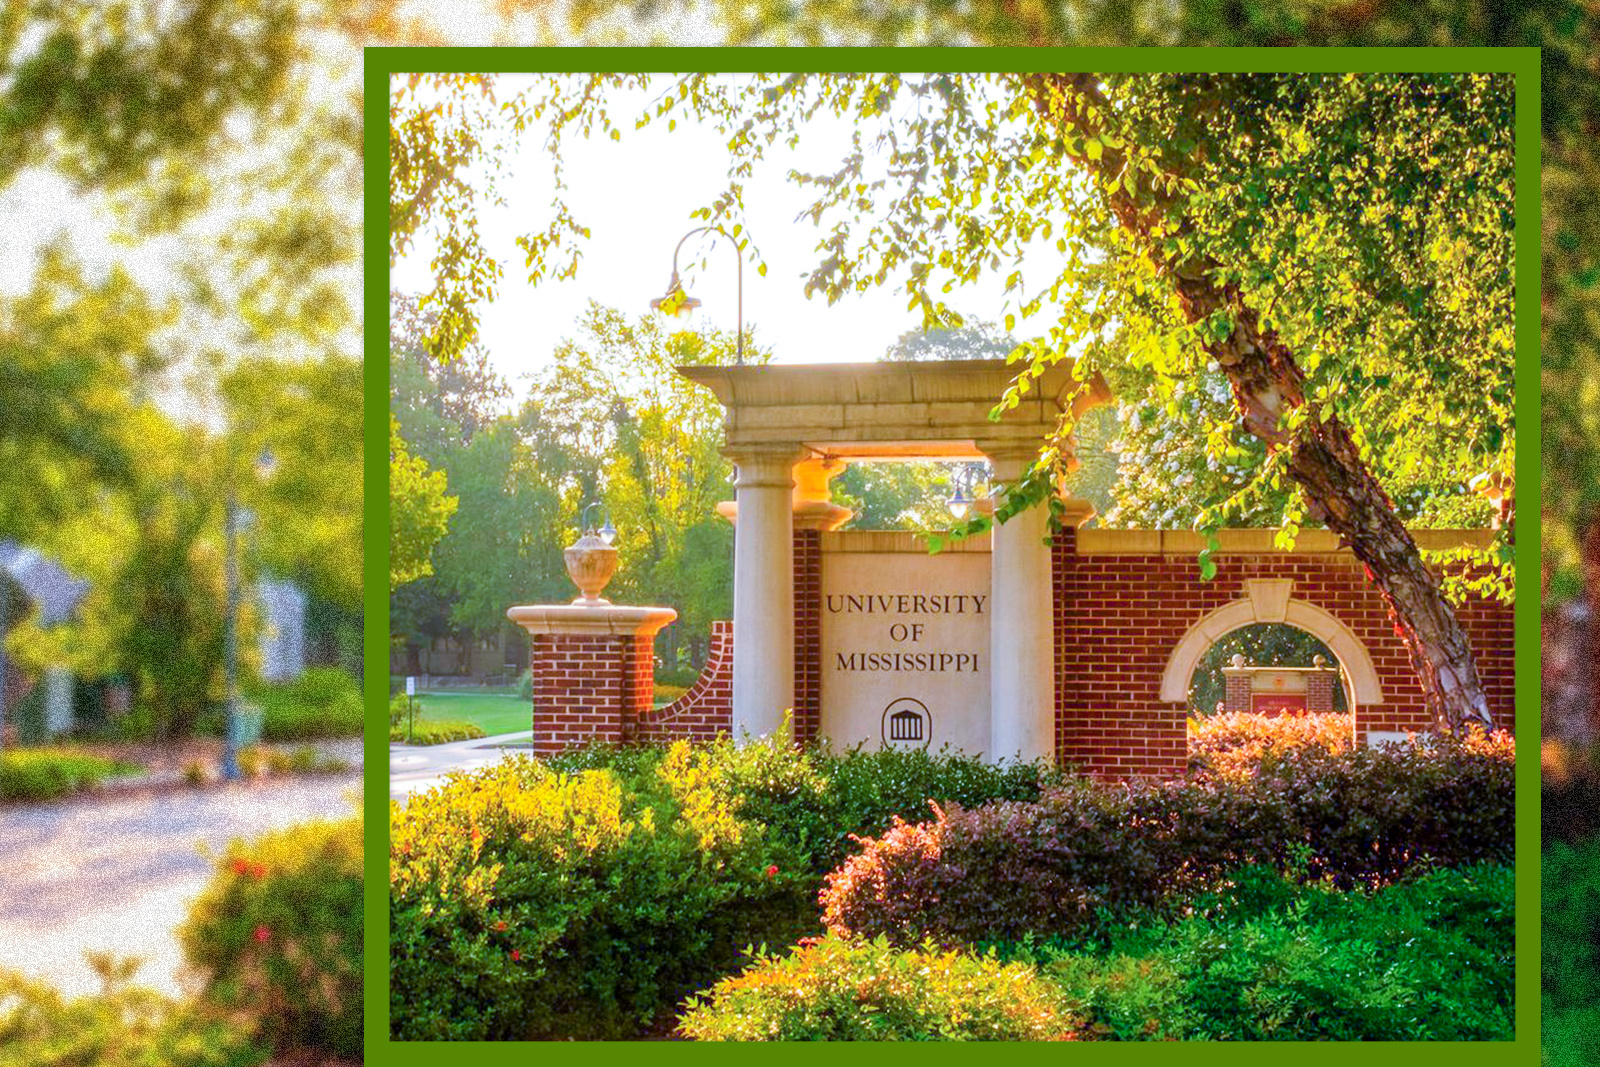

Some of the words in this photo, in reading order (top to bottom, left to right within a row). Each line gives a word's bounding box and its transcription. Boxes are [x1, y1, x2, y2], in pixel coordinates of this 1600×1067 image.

[827, 594, 987, 613] UNIVERSITY
[889, 623, 924, 642] OF
[836, 652, 979, 672] MISSISSIPPI
